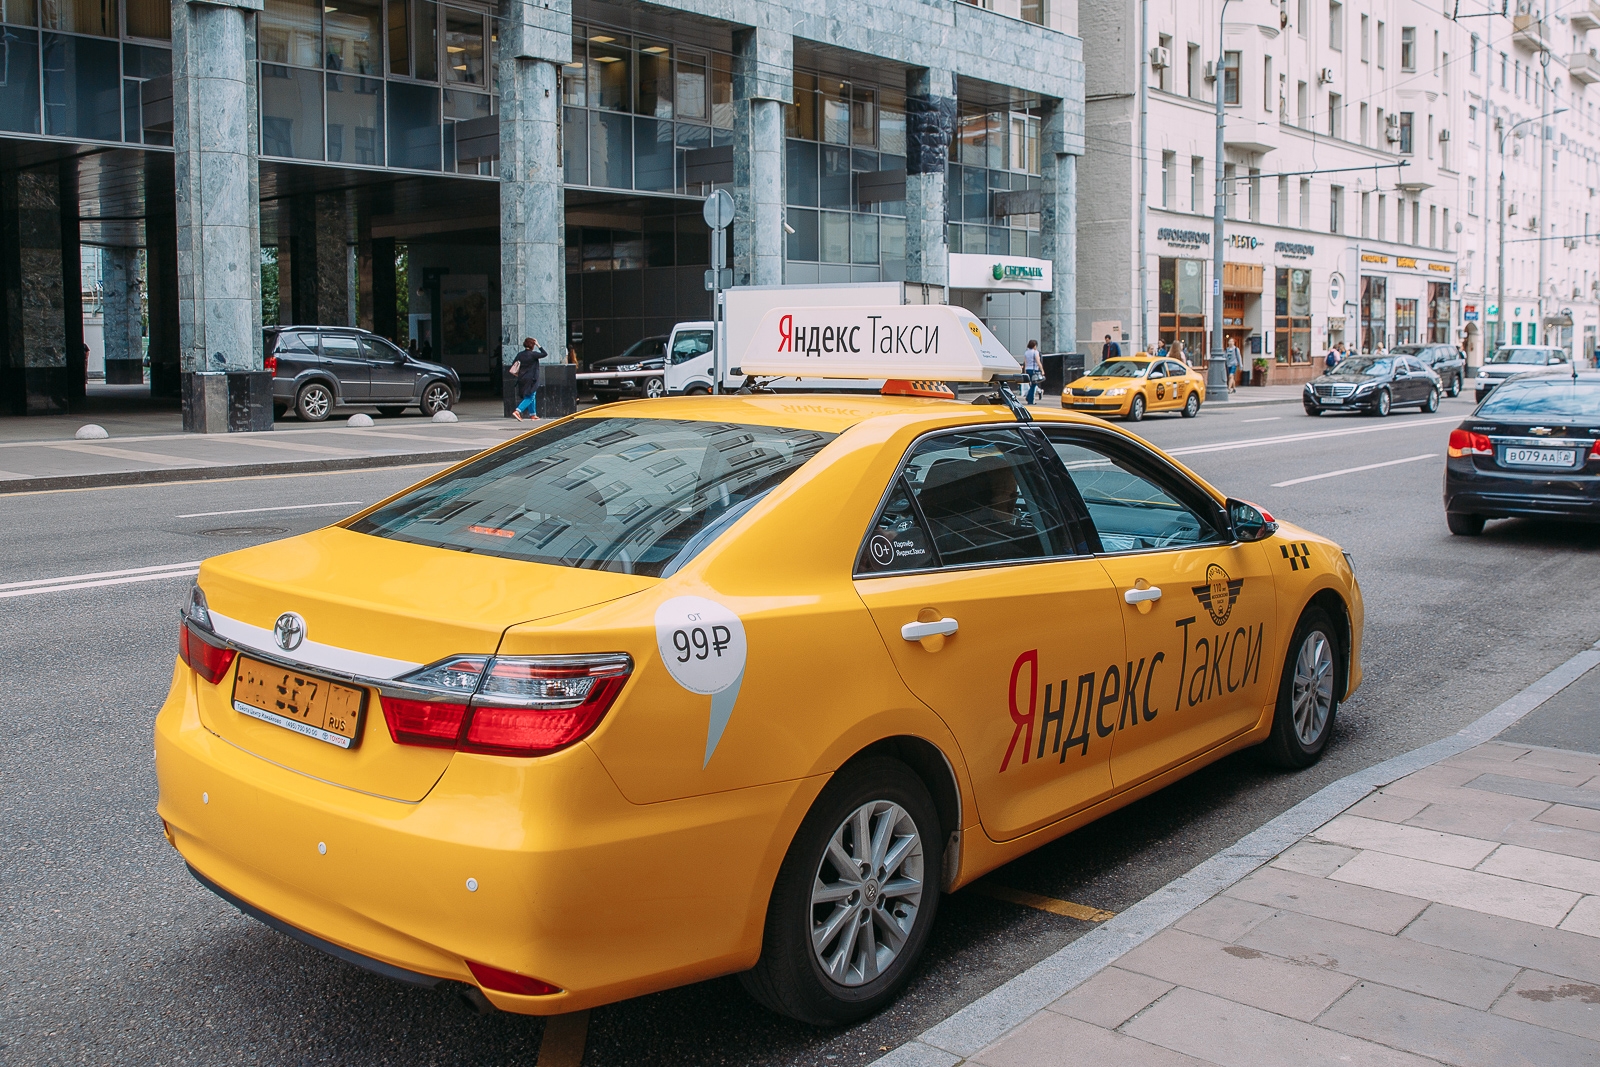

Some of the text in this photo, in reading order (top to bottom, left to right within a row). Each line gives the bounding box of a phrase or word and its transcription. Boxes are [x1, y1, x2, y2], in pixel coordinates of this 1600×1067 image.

[777, 315, 939, 357] Яндекс Такси
[999, 616, 1263, 773] Яндекс Такси
[329, 717, 346, 731] RUS
[329, 734, 346, 745] TOYOTA
